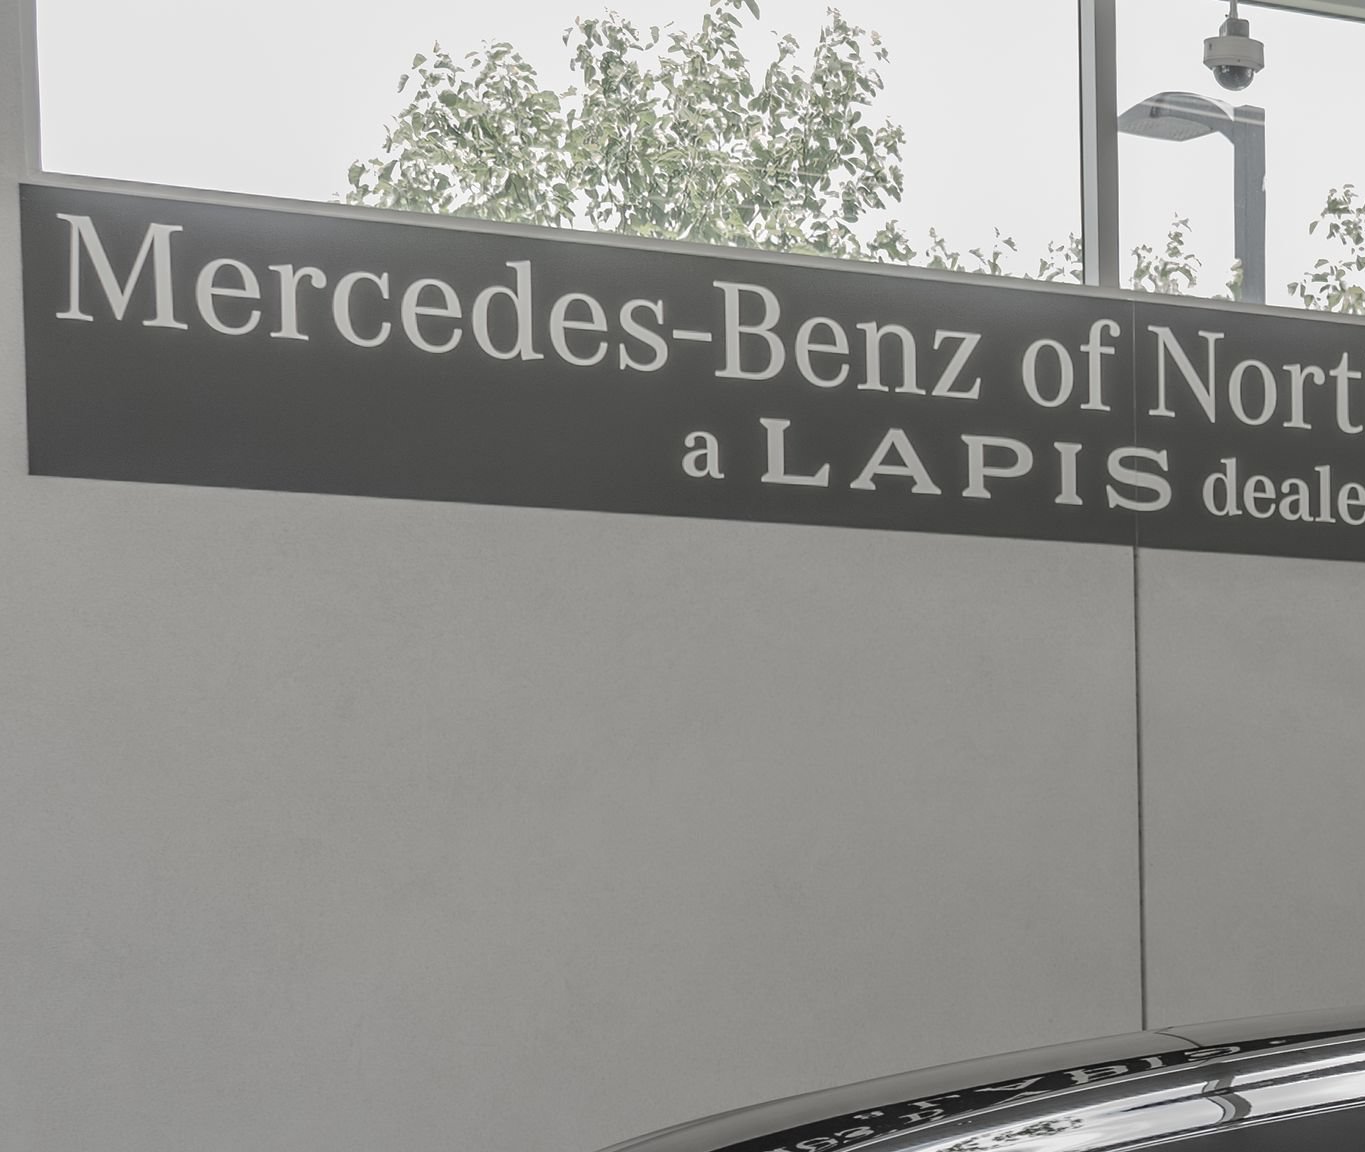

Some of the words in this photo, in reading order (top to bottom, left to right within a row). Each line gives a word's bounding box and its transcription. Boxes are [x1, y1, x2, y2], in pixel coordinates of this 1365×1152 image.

[56, 213, 982, 401] Mercedes-Benz
[1021, 318, 1121, 413] of
[681, 430, 725, 480] a
[759, 417, 1173, 514] LAPIS
